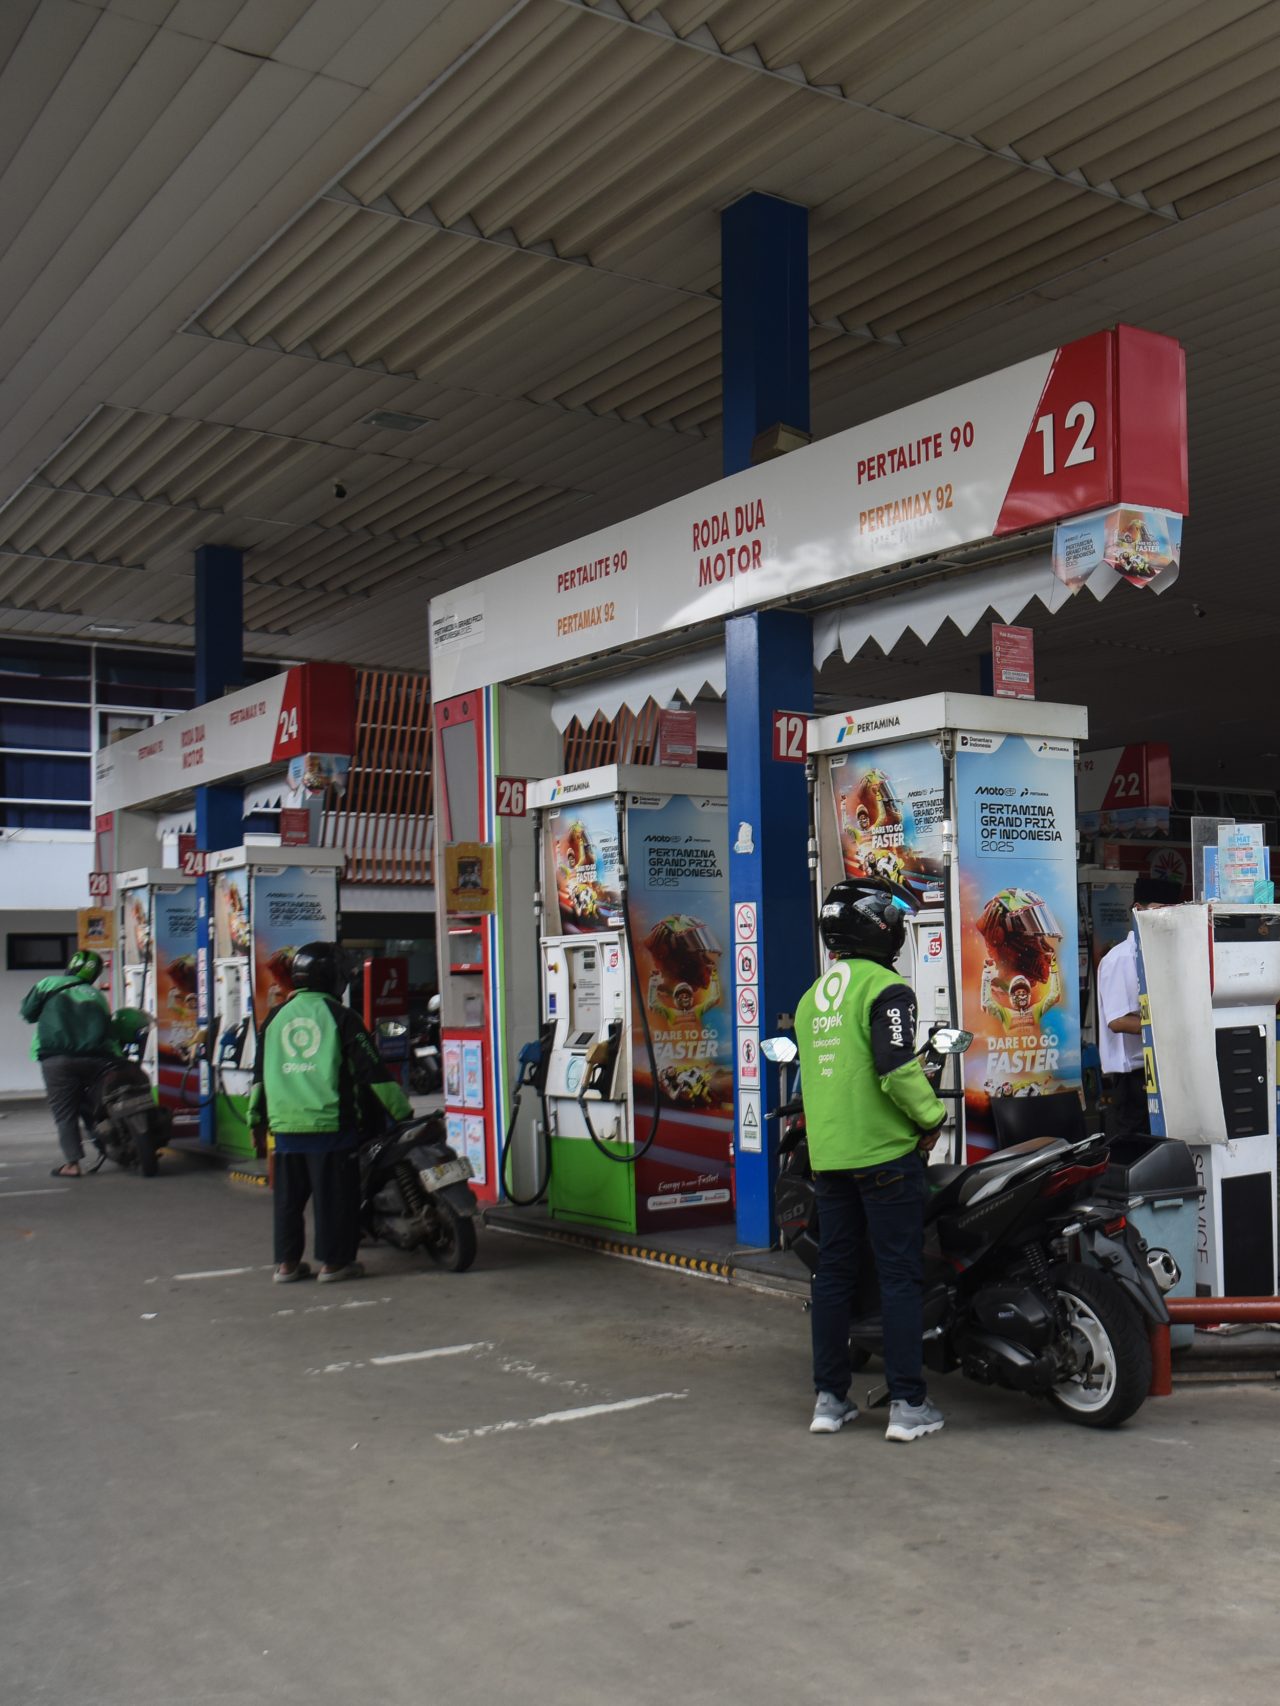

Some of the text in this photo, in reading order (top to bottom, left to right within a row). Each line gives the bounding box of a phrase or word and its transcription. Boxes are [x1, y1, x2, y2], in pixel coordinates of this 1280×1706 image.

[1035, 401, 1096, 477] 12
[857, 420, 975, 485] PERTALITE 90
[858, 483, 954, 535] PERTAMAX 92
[692, 498, 766, 552] RODA DUA
[557, 550, 628, 594] PERTALITE 90
[698, 539, 763, 588] MOTOR
[557, 602, 615, 637] PERTAMAX 92
[279, 707, 299, 744] 24
[857, 716, 900, 734] PERTAMINA
[775, 717, 804, 757] 12
[563, 780, 591, 794] PERTAMINA
[1114, 773, 1140, 798] 22
[499, 780, 524, 815] 26
[911, 798, 945, 809] PERTAMIN
[912, 806, 935, 817] GRAND
[980, 803, 1054, 817] PERTAMINA
[885, 825, 893, 834] TO
[914, 817, 923, 826] OF
[980, 816, 1056, 829] GRAND PRIX
[871, 832, 905, 849] FASTER
[981, 828, 1063, 841] OF INDONESIA
[648, 847, 716, 859] PERTAMINA
[981, 840, 1015, 853] 2025
[184, 852, 203, 875] 24
[648, 858, 717, 868] GRAND PRIX
[576, 871, 598, 882] FASTER
[648, 867, 723, 878] OF INDONESIA
[90, 874, 109, 896] 28
[648, 877, 680, 887] 2025
[812, 1013, 843, 1034] gojek
[886, 1008, 904, 1047] gopay
[653, 1028, 719, 1042] DARE TO GO
[812, 1038, 841, 1048] tokopedia
[986, 1034, 1059, 1051] DARE TO GO
[654, 1041, 720, 1061] FASTER
[818, 1052, 836, 1064] gopay
[986, 1048, 1060, 1074] FASTER
